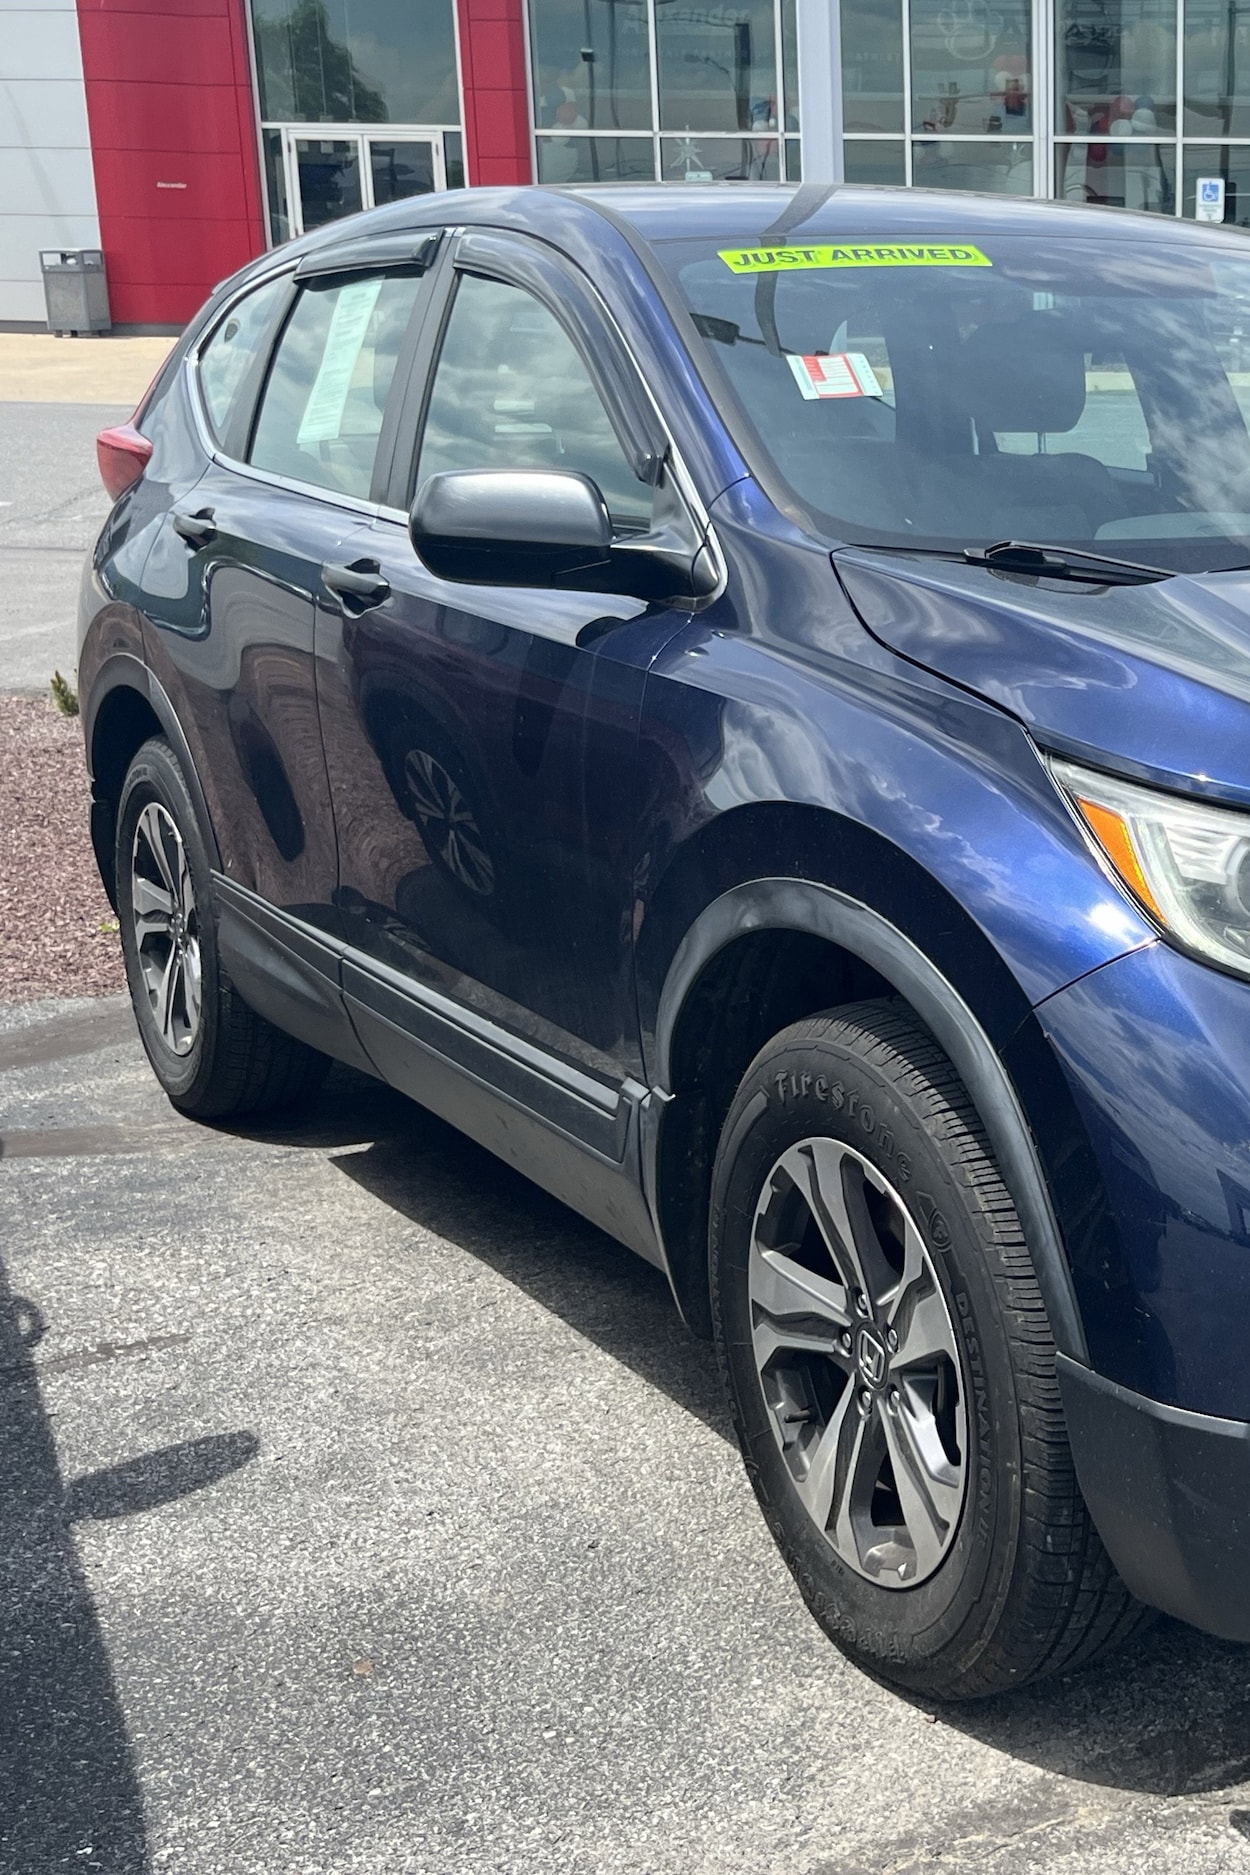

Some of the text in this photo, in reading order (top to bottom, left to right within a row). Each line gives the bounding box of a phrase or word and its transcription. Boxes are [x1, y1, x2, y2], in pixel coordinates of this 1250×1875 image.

[734, 248, 973, 267] JUST ARRIVED
[774, 1068, 913, 1183] Firestone
[955, 1291, 994, 1514] DESTINATION
